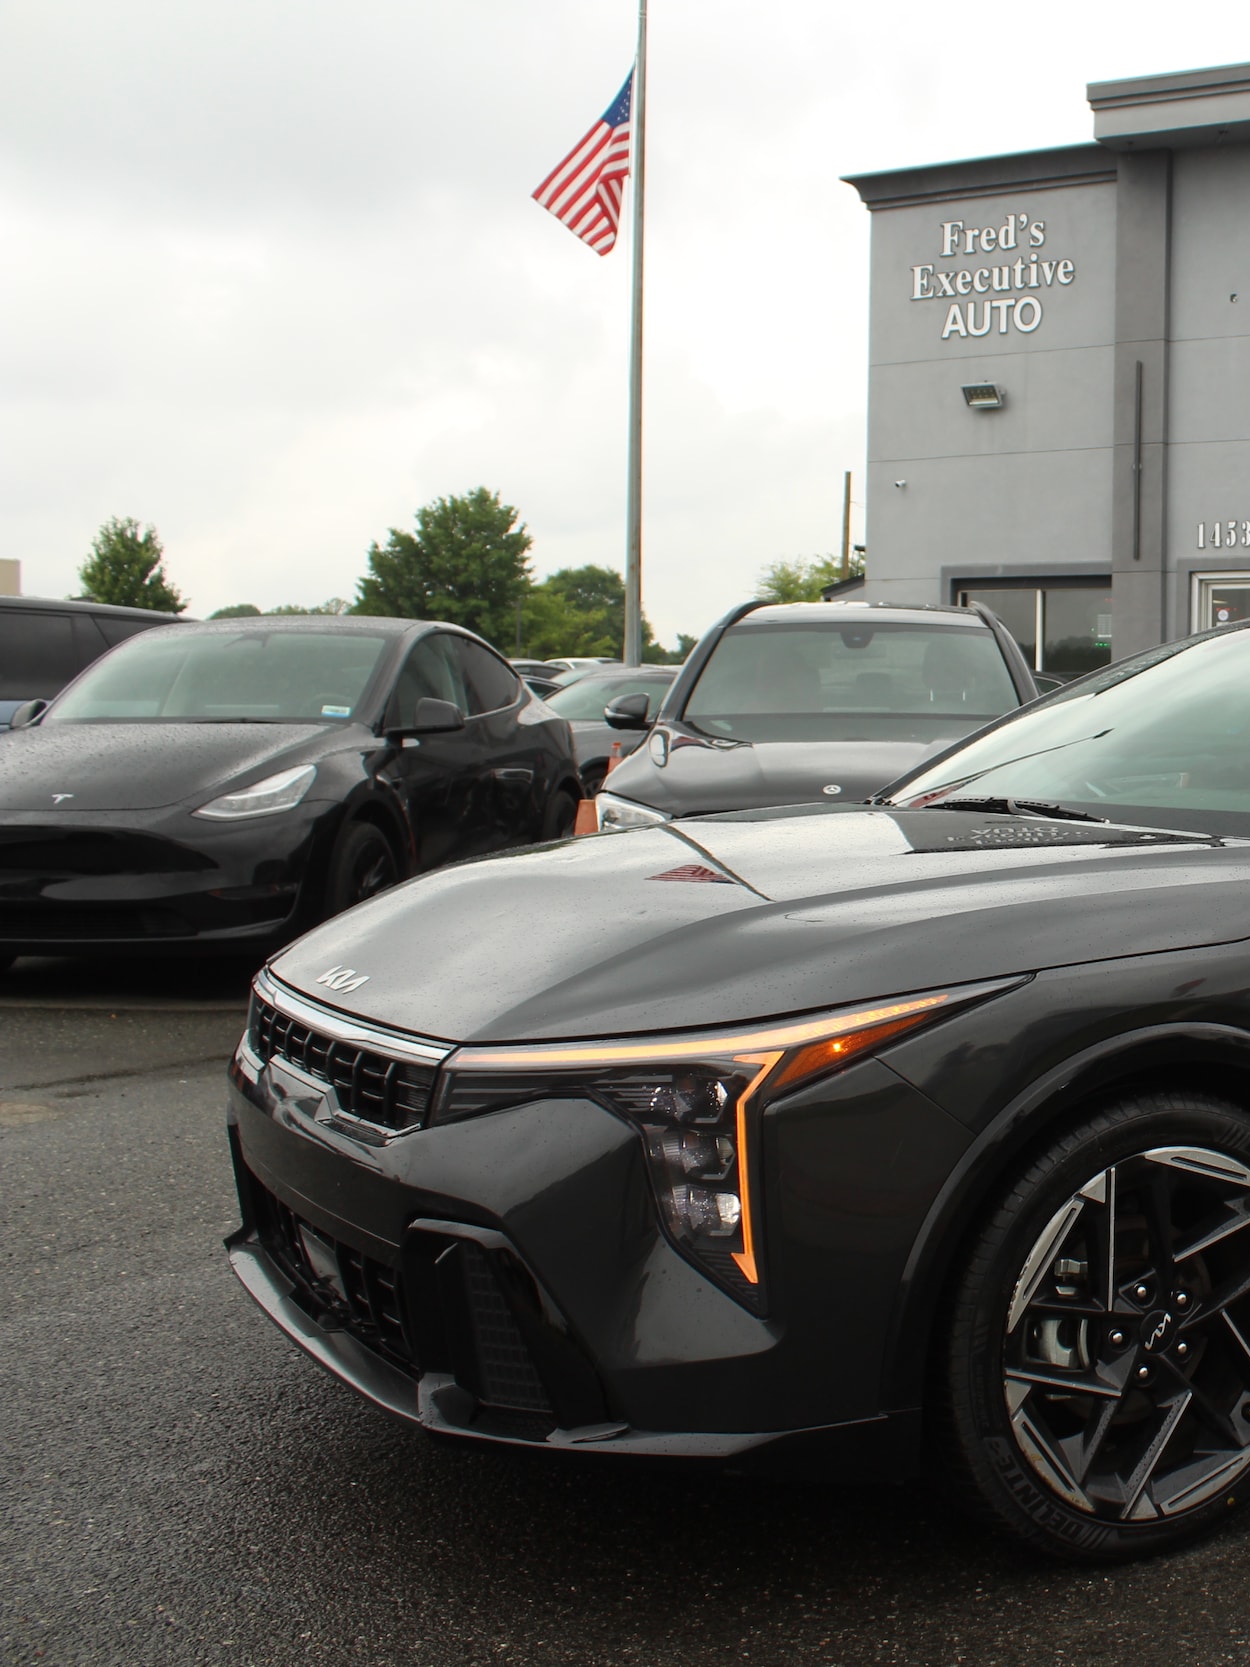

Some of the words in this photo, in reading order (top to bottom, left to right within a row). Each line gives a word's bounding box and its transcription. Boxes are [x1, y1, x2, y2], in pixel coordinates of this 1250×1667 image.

[940, 213, 1046, 257] Fred's
[910, 253, 1075, 300] Executive
[941, 295, 1042, 339] AUTO
[999, 1453, 1085, 1542] DELINTE
